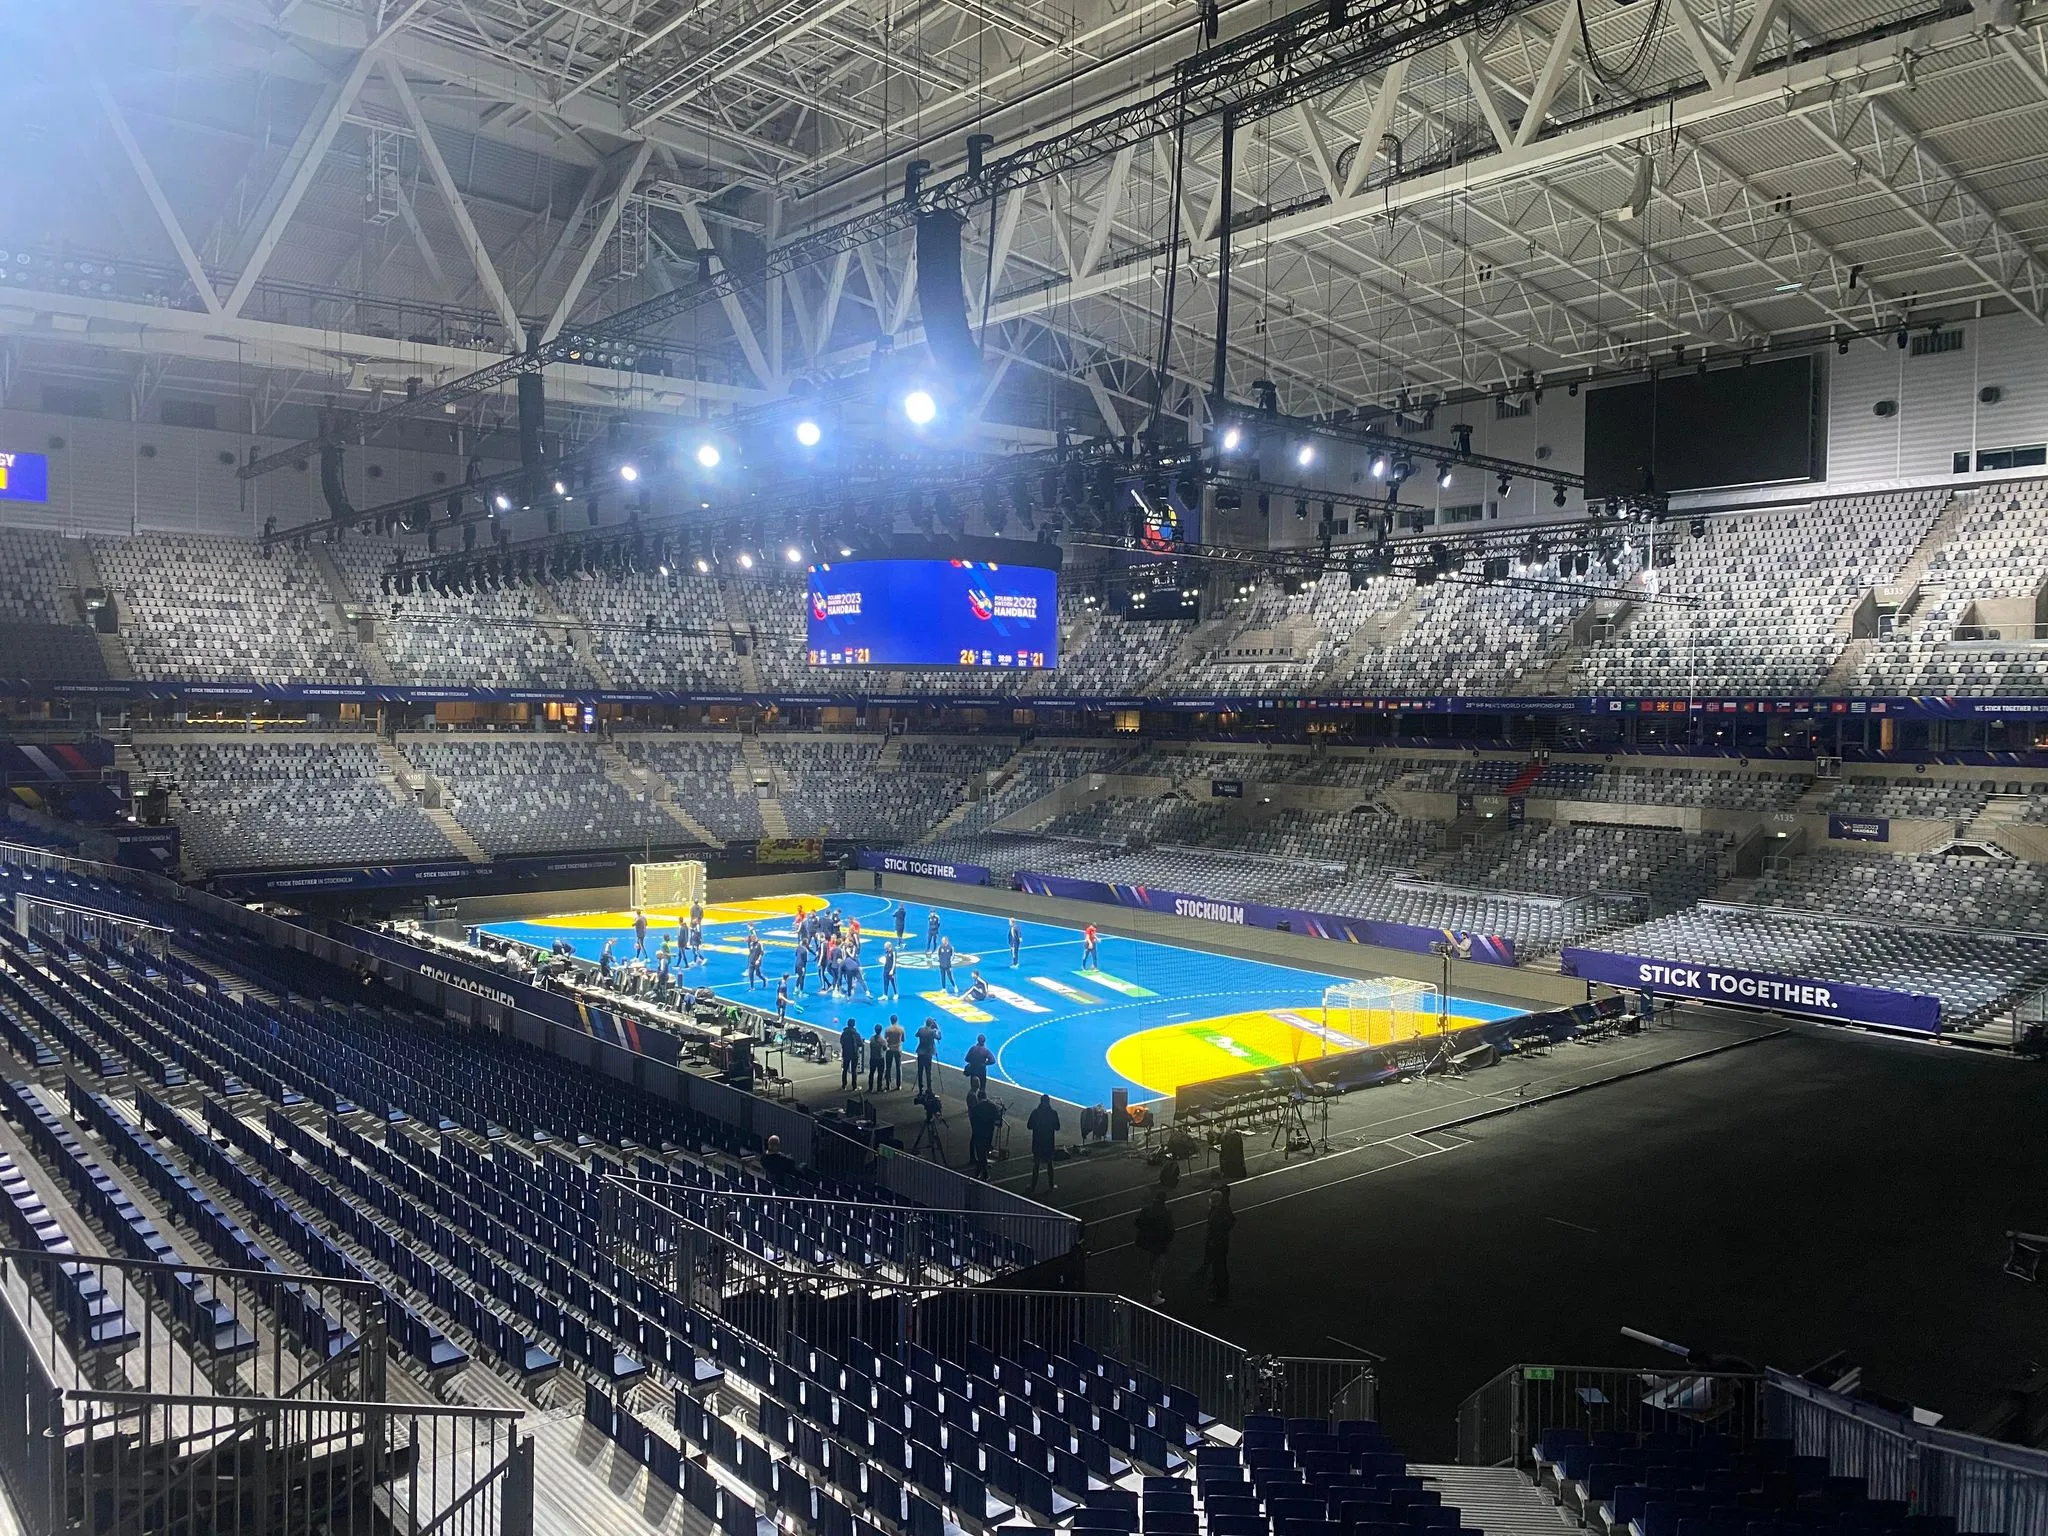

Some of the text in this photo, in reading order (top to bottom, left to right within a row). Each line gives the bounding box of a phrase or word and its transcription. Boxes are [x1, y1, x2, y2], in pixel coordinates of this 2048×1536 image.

[841, 592, 862, 605] 2023
[1884, 587, 1904, 596] B335
[827, 603, 861, 616] HANDBALL
[1013, 596, 1037, 609] 2023
[994, 606, 1037, 619] HANDBALL
[858, 648, 870, 663] 21
[960, 649, 975, 665] 26
[1032, 652, 1044, 667] 21
[1773, 813, 1795, 823] A135
[884, 857, 957, 878] STICK TOGETHER.
[1175, 898, 1244, 925] STOCKHOLM
[420, 963, 515, 1008] STICK TOGETHER
[1638, 963, 1838, 1009] STICK TOGETHER.
